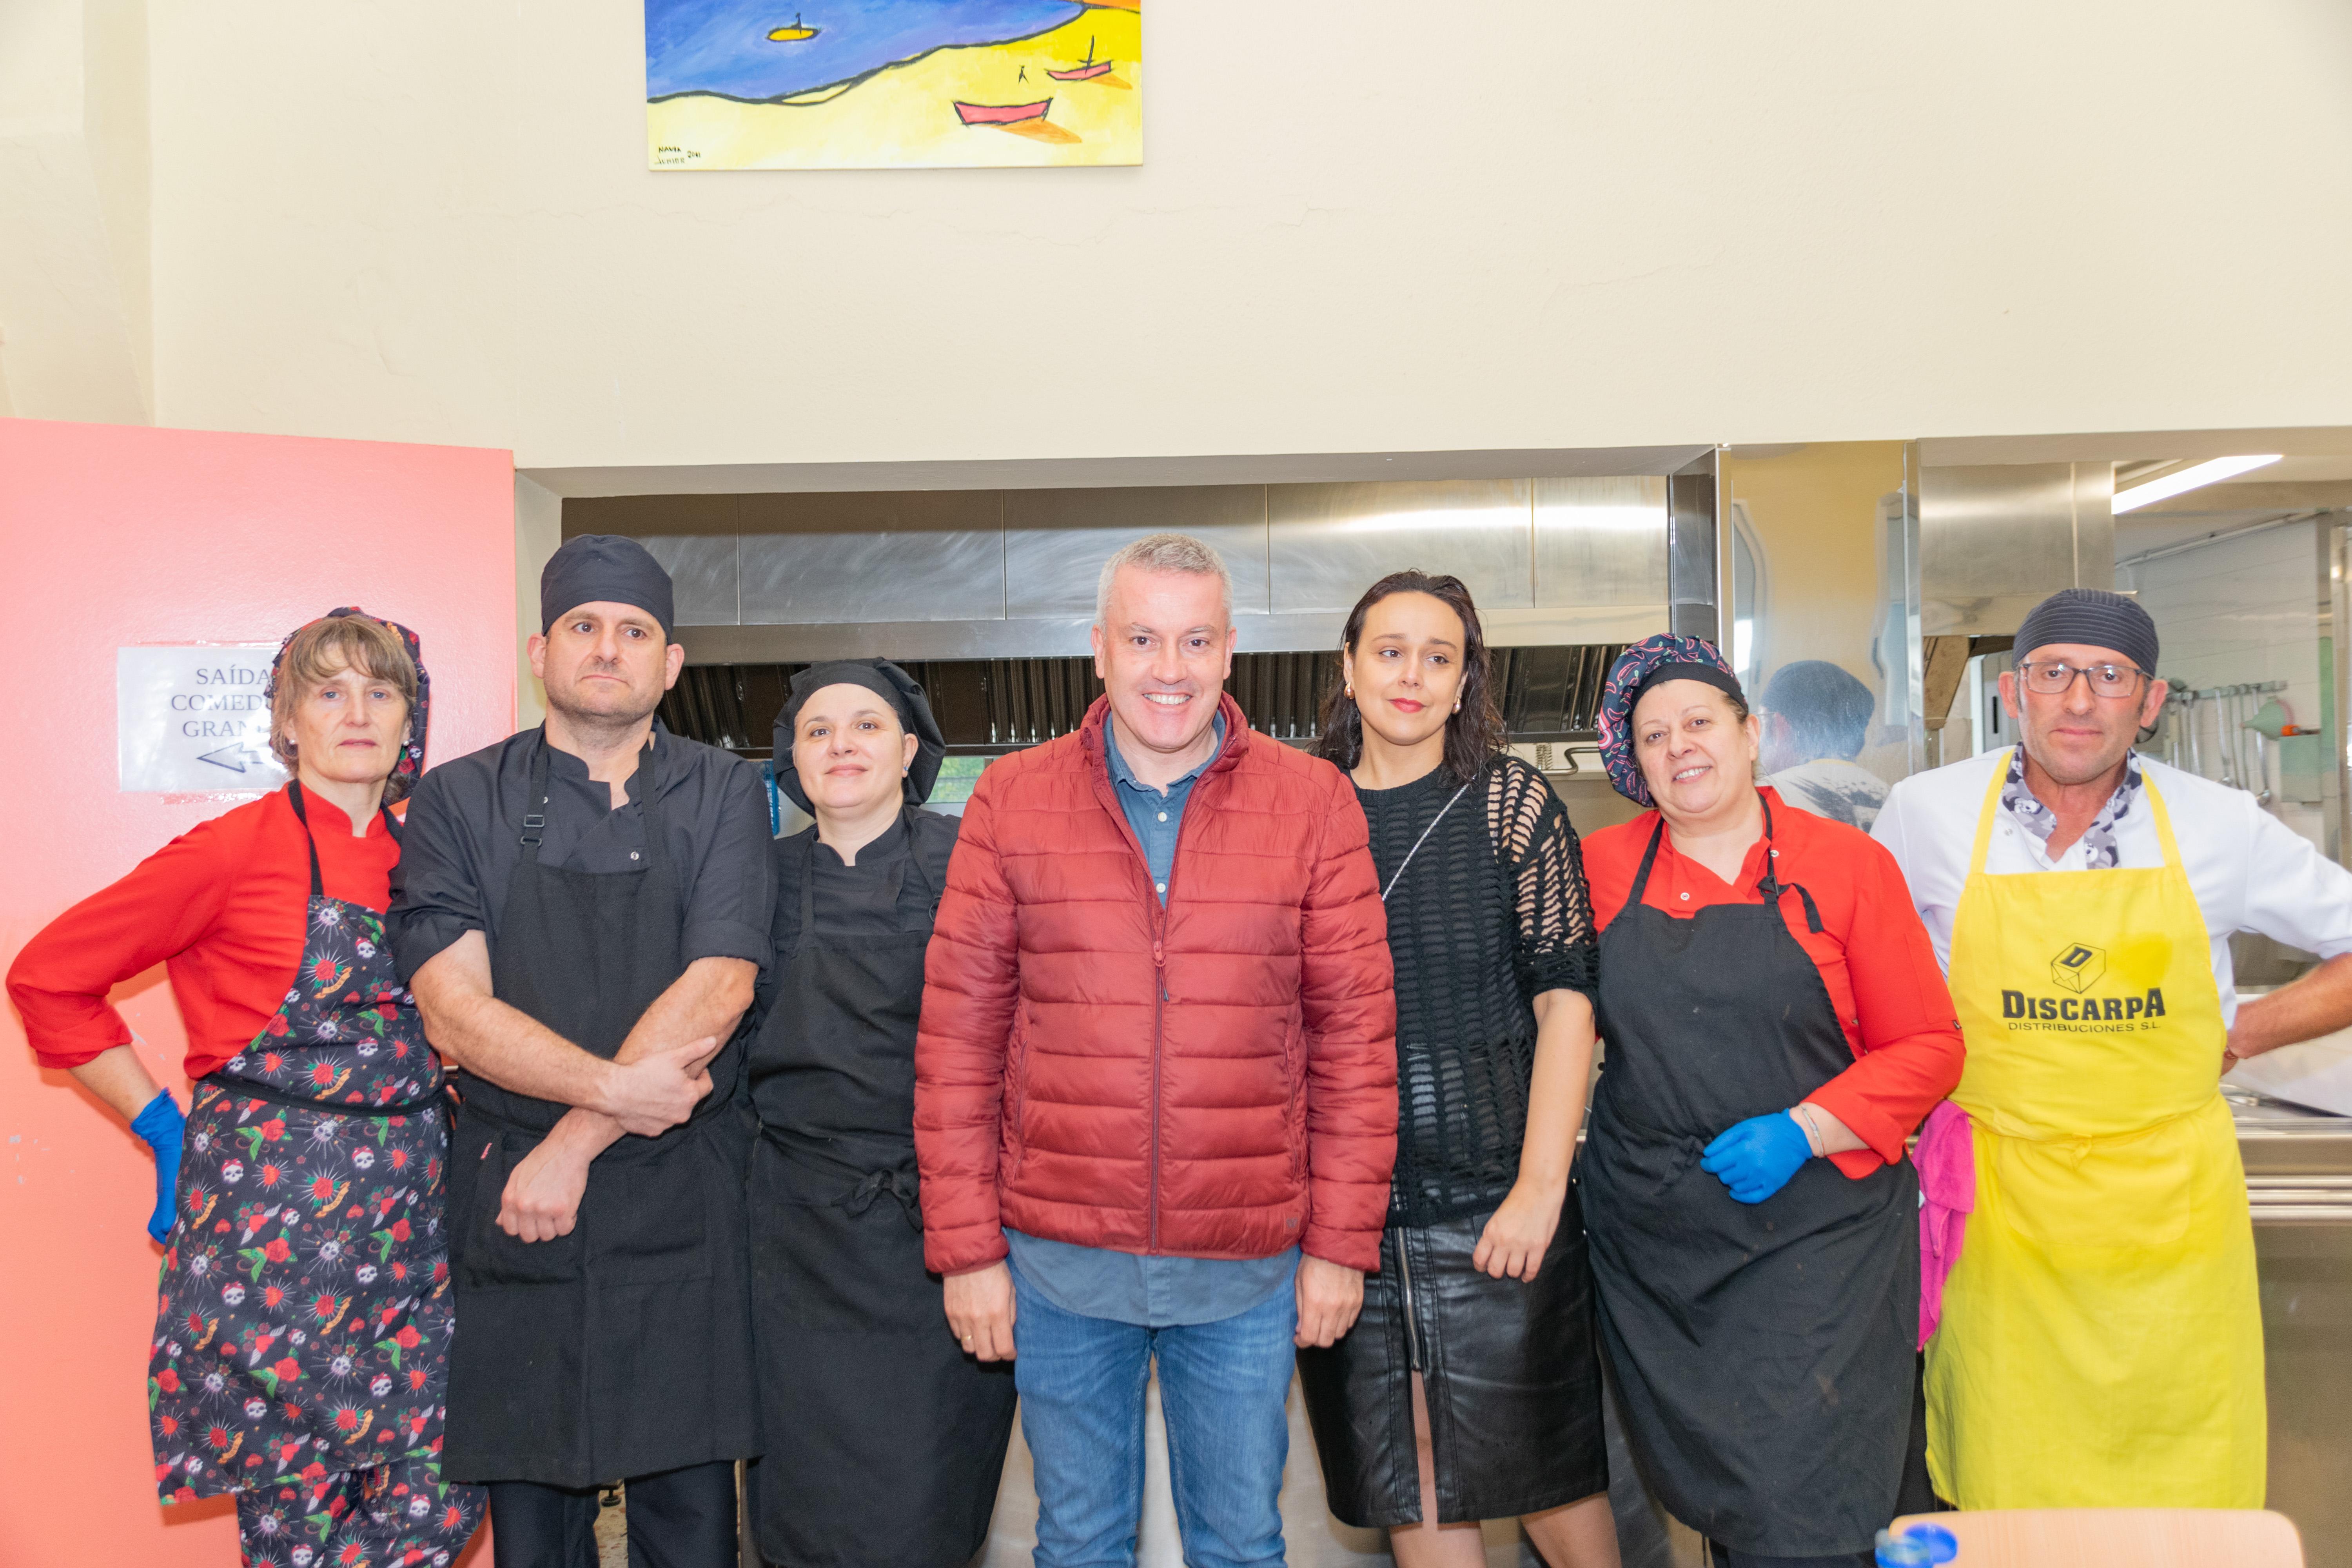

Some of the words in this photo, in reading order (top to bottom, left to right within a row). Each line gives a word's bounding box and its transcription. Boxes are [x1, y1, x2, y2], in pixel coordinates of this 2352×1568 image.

[196, 664, 270, 685] SAÍDA
[2001, 987, 2166, 1021] DISCARPA
[2008, 1022, 2134, 1033] DISTRIBUCIONES
